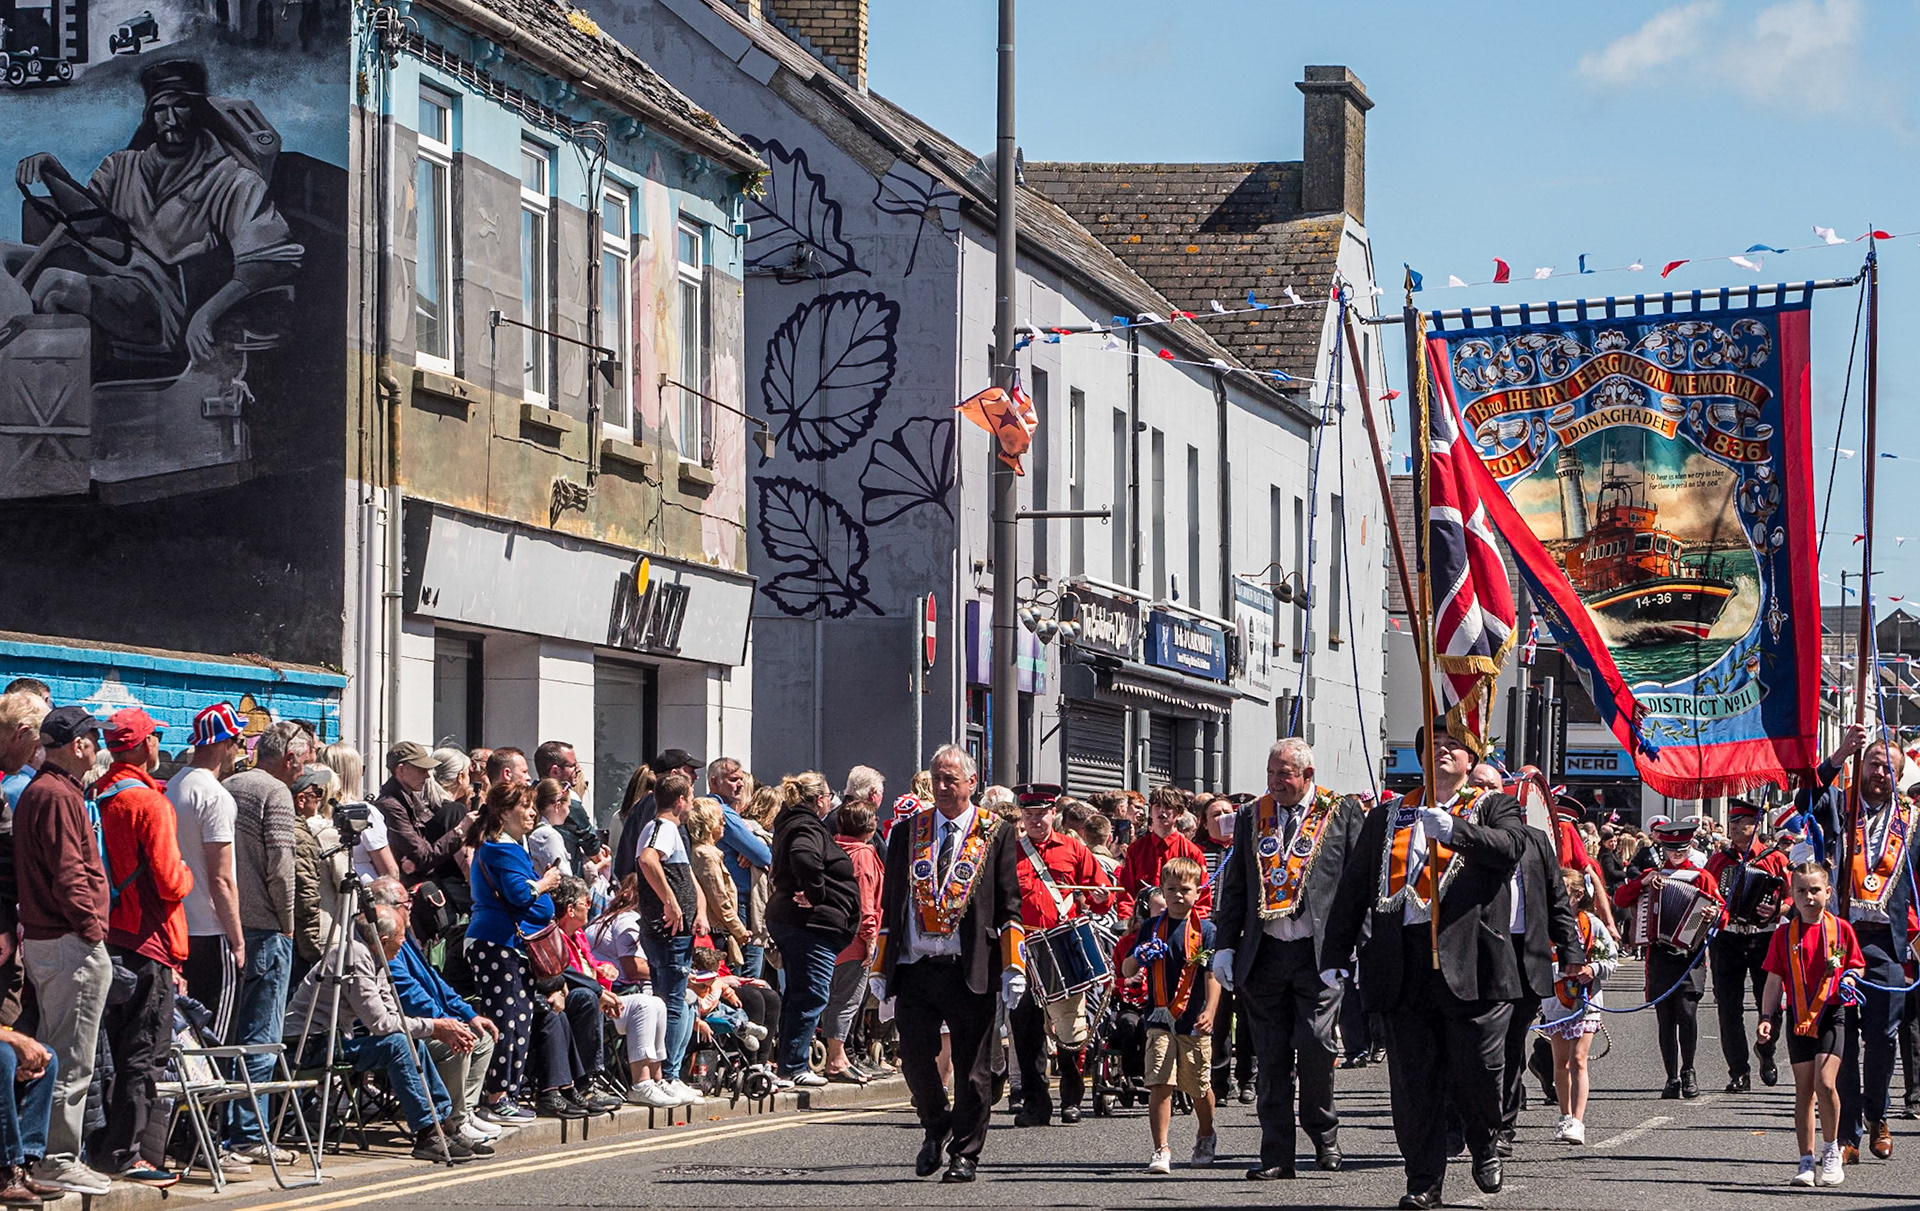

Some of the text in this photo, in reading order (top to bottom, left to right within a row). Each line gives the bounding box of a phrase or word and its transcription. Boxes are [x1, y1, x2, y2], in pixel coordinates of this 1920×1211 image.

[30, 61, 40, 73] 12
[1508, 382, 1572, 410] HENRY
[1574, 354, 1668, 391] FERGUSON
[1671, 375, 1761, 402] MEMORIAL
[1568, 409, 1671, 441] DONAGHADEE
[1714, 435, 1762, 461] 836
[1635, 592, 1673, 609] 14-36
[1649, 697, 1718, 716] DISTRICT
[1567, 758, 1618, 770] NERO
